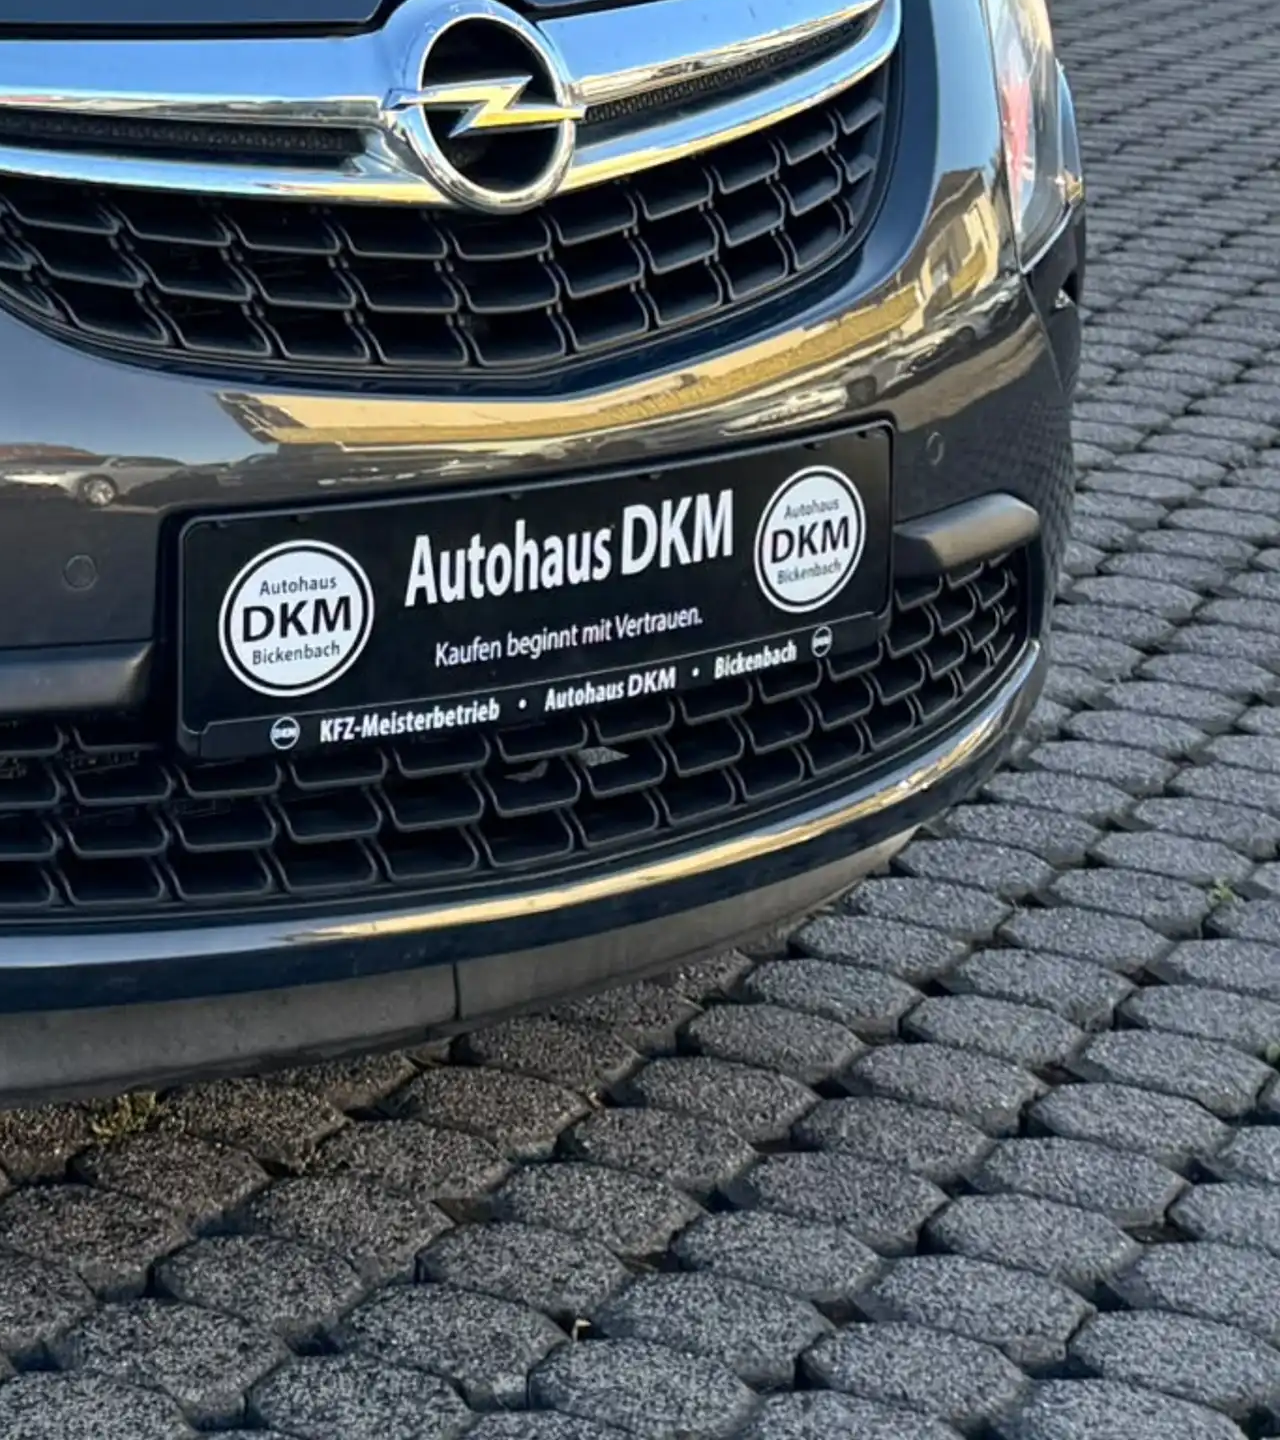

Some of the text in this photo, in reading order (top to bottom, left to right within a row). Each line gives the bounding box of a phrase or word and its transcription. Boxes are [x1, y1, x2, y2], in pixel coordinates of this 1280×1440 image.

[783, 498, 840, 520] Autohaus
[404, 489, 733, 607] Autohaus DKM
[770, 515, 850, 564] DKM
[259, 576, 338, 597] Autohaus
[776, 558, 842, 585] Bickenbach
[243, 595, 352, 643] DKM
[435, 606, 704, 668] Kaufen beginnt mit Vertrauen.
[252, 640, 341, 665] Bickenbach
[320, 641, 798, 742] KFZ-Meisterbetrieb Autohaus DKM Bickenbach
